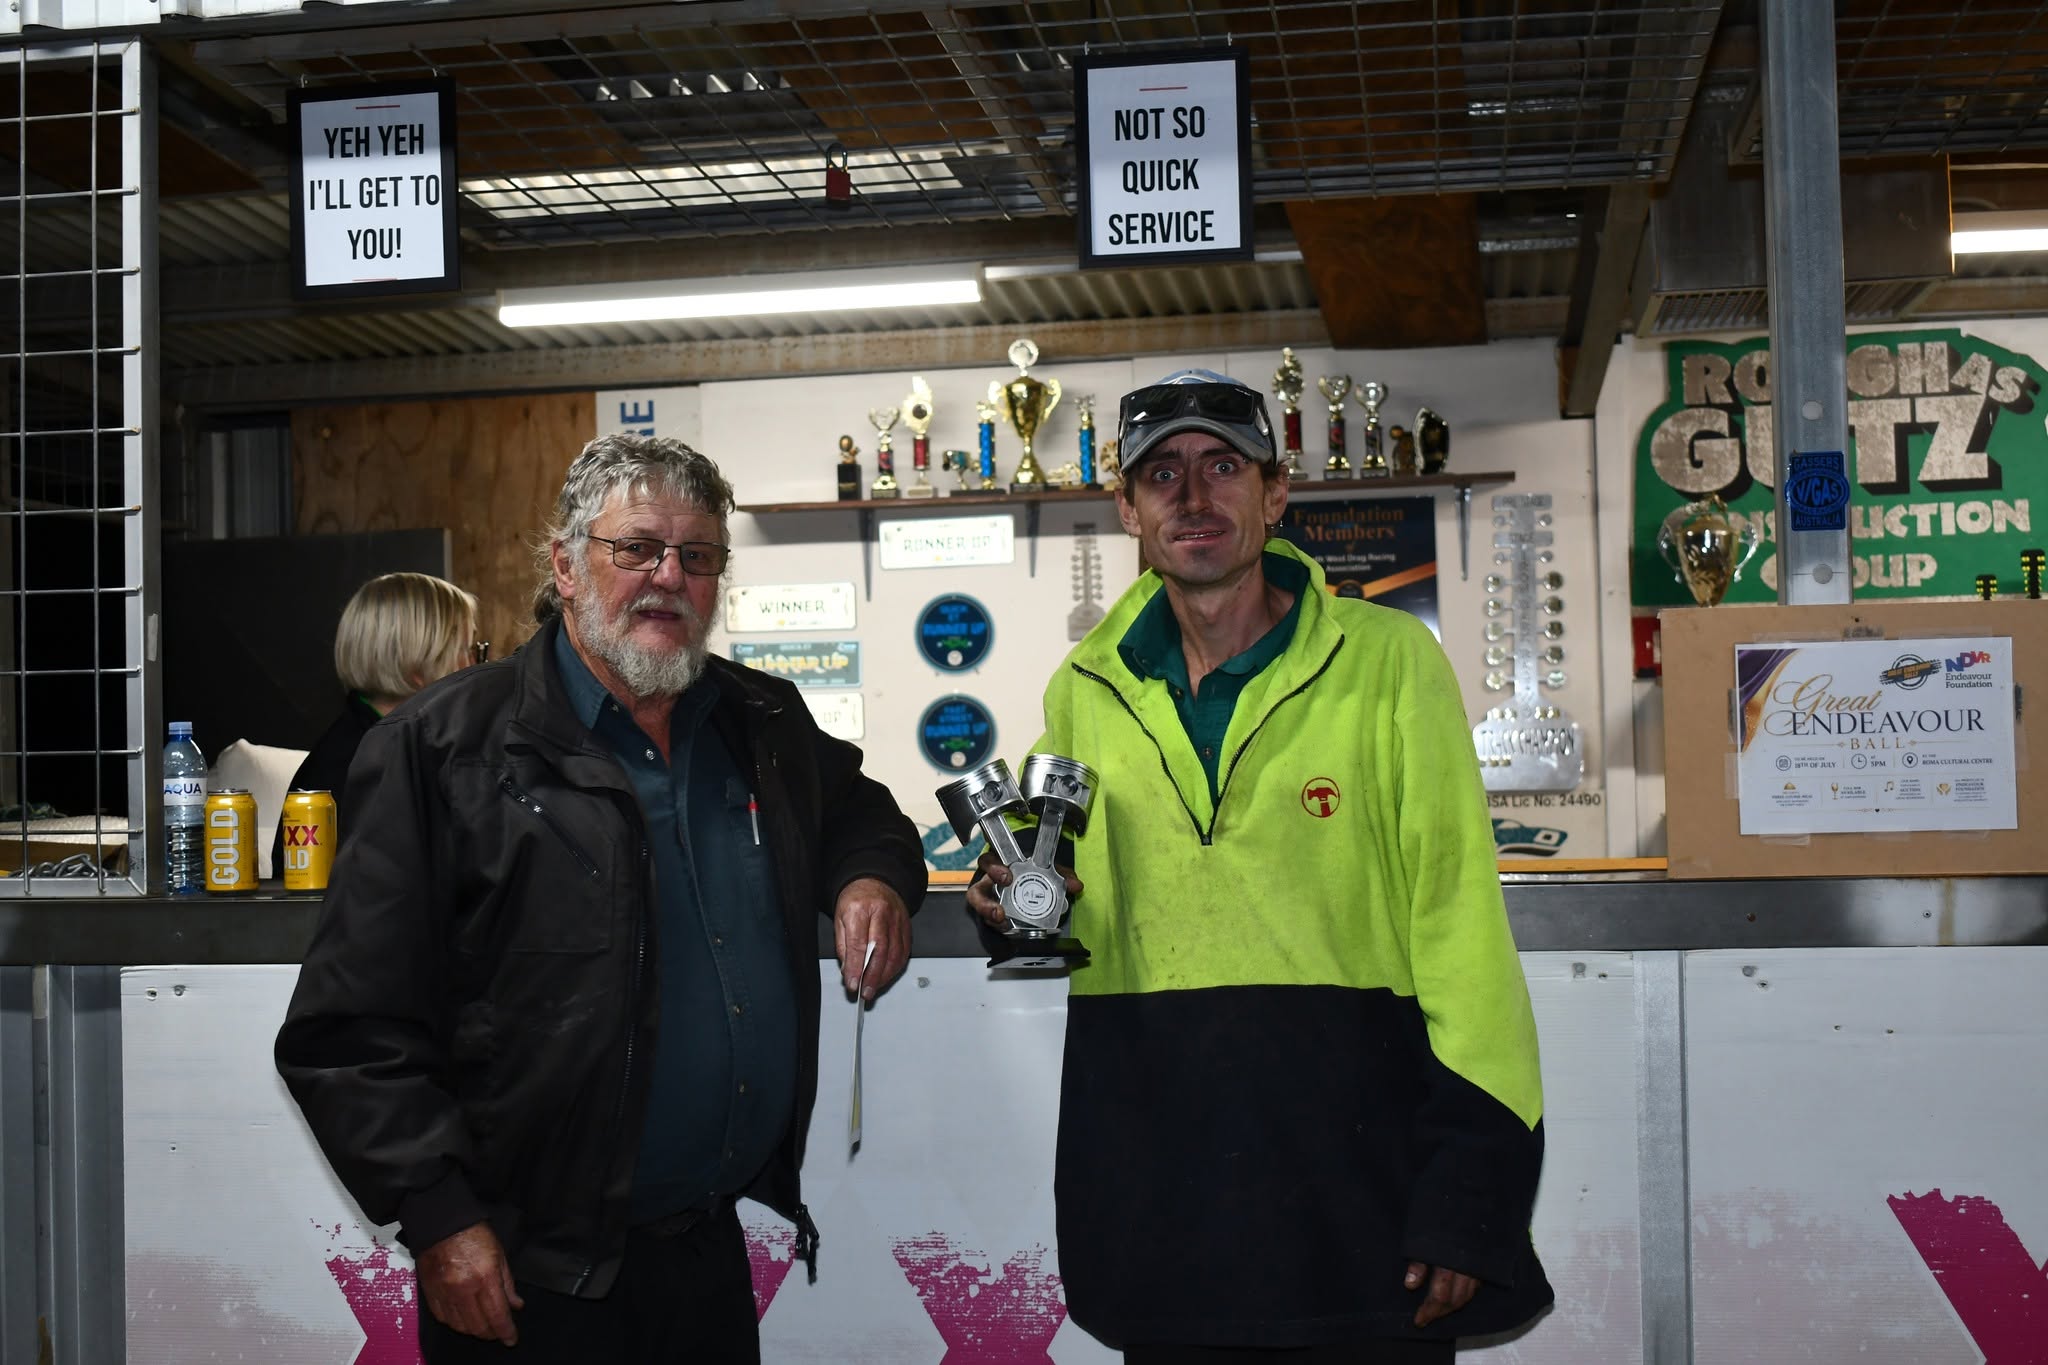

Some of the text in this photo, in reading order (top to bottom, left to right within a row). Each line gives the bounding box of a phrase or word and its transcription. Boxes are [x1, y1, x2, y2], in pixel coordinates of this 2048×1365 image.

[1114, 105, 1205, 141] NOT SO
[323, 123, 424, 159] YEH YEH
[309, 174, 440, 211] I'LL GET TO
[1122, 158, 1200, 195] QUICK
[347, 227, 402, 260] YOU!
[1108, 209, 1215, 246] SERVICE
[1682, 341, 1949, 405] ROGH
[1293, 506, 1404, 525] Foundation
[1304, 524, 1396, 542] Members
[1760, 552, 1938, 591] OUP
[759, 600, 825, 614] WINNER
[1945, 672, 1993, 681] Endeavour
[1945, 680, 1993, 689] Foundation
[1768, 673, 1885, 722] Great
[1791, 708, 1985, 736] ENDEAVOUR
[1850, 737, 1906, 750] BALL
[164, 783, 203, 796] AQUA
[1511, 795, 1530, 808] Lic
[1533, 795, 1555, 808] No:
[1559, 794, 1601, 807] 24490
[210, 809, 240, 885] GOLD
